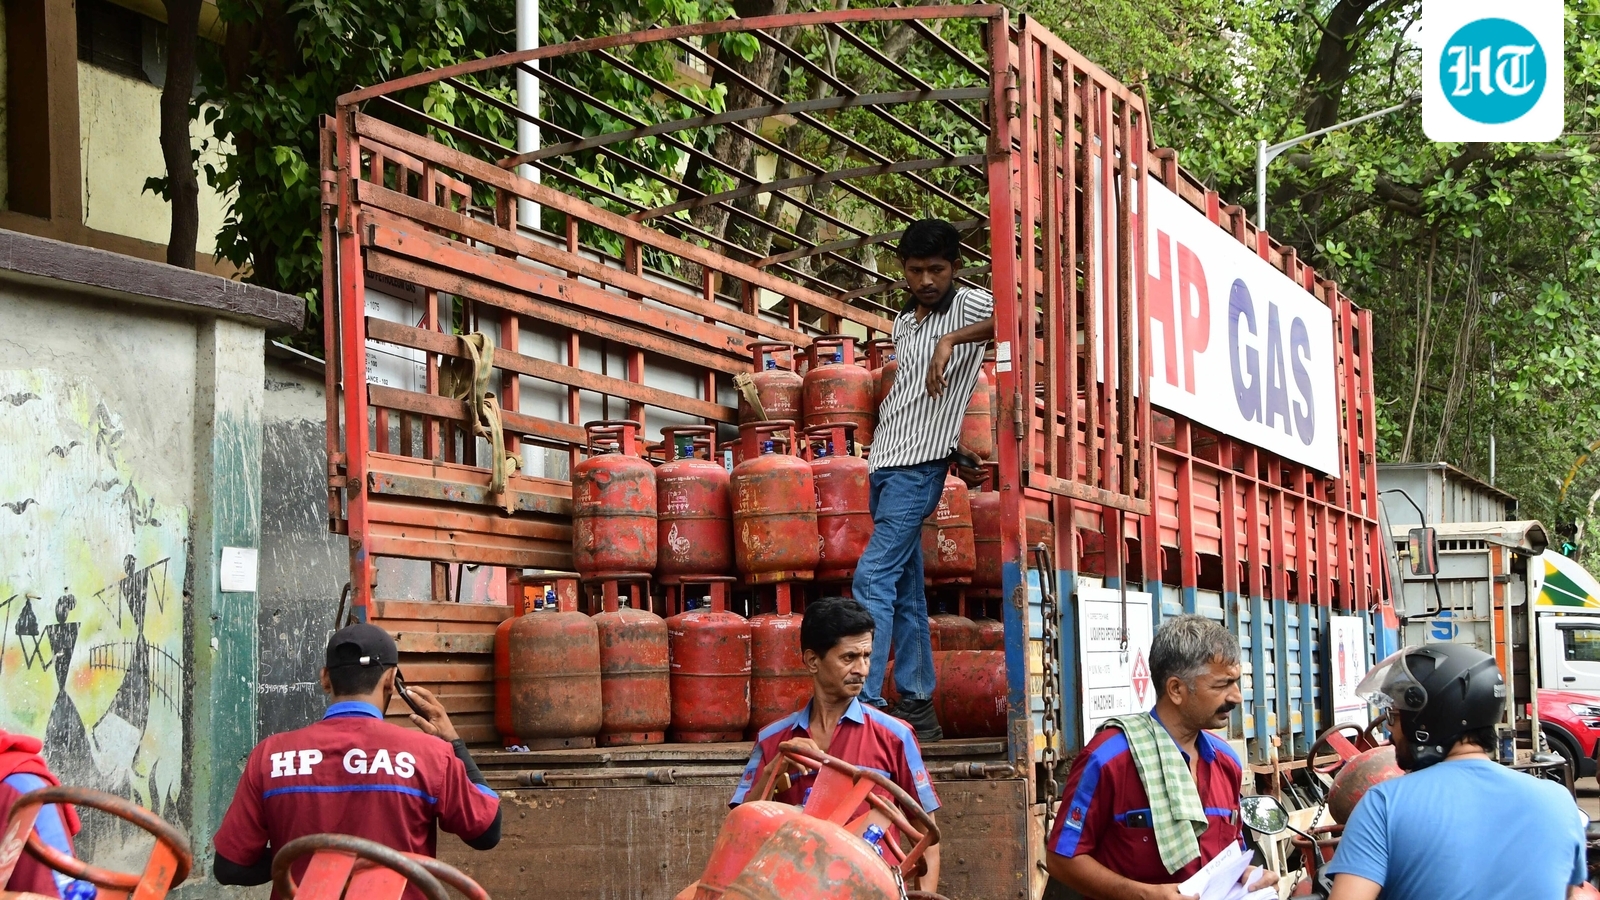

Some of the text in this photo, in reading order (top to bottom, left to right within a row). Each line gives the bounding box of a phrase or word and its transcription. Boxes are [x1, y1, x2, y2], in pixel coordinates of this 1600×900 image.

[1132, 212, 1315, 446] HP GAS
[1138, 680, 1144, 698] 2
[1093, 694, 1114, 710] HAZCHEM
[270, 748, 416, 779] HP GAS
